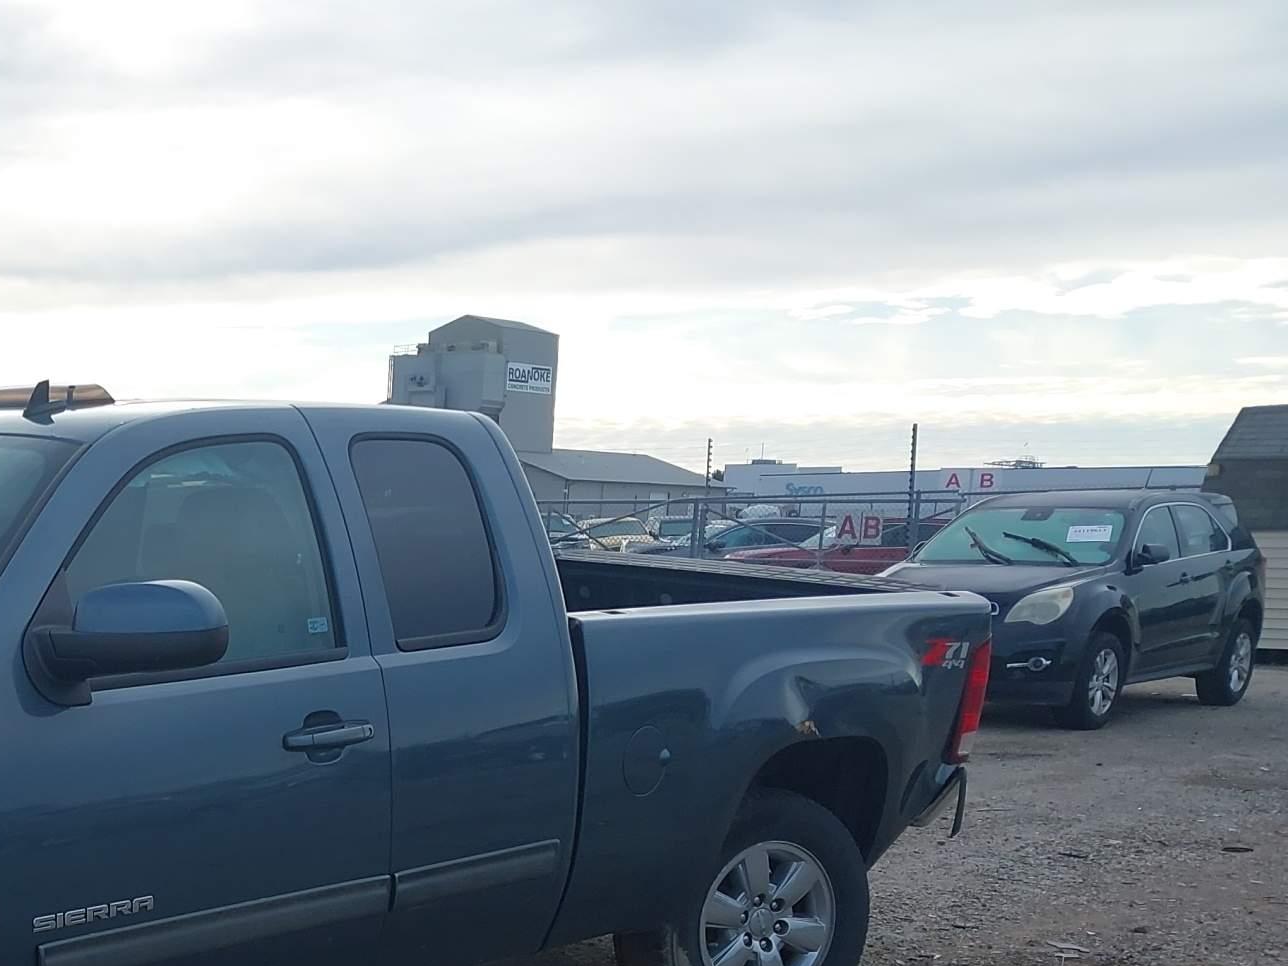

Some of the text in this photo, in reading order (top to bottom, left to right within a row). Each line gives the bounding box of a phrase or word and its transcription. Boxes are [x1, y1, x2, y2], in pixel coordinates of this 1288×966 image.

[508, 367, 551, 383] ROANOKE
[785, 482, 824, 496] Sysco
[945, 473, 994, 489] A B
[837, 515, 881, 540] A B
[32, 895, 154, 933] SIERRA
